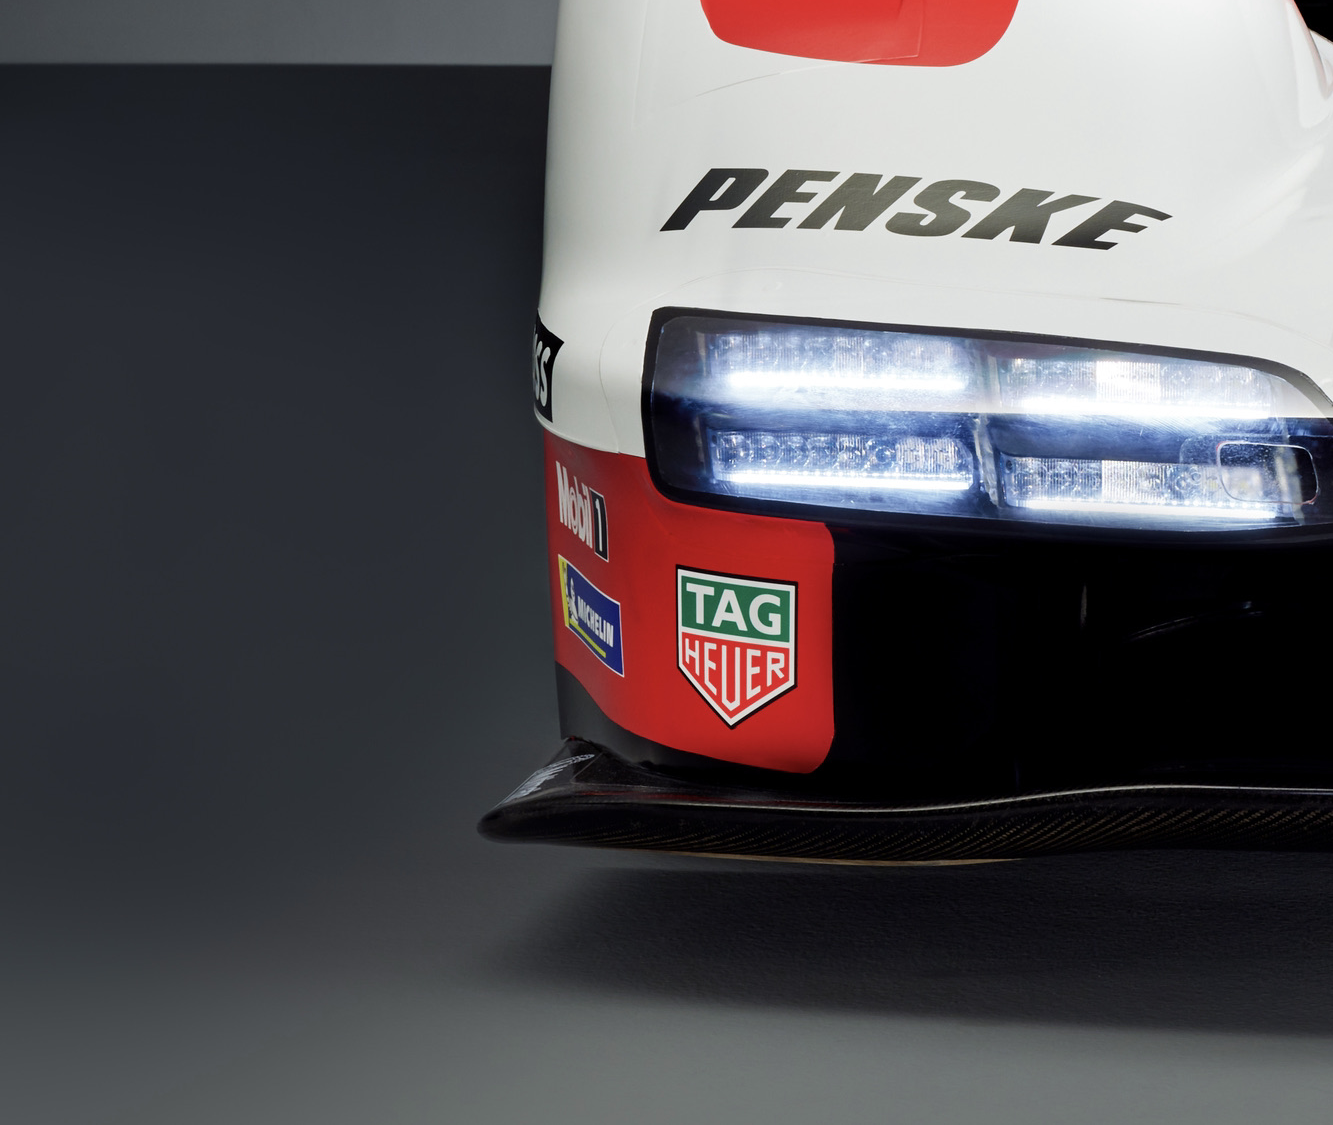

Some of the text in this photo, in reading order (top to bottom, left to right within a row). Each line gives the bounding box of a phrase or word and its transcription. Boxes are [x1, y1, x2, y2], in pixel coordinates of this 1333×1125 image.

[660, 167, 1173, 250] PENSKE
[556, 461, 593, 549] Mobil
[577, 595, 614, 648] MICHELIN
[686, 583, 781, 636] TAG
[685, 638, 785, 712] HEUER
